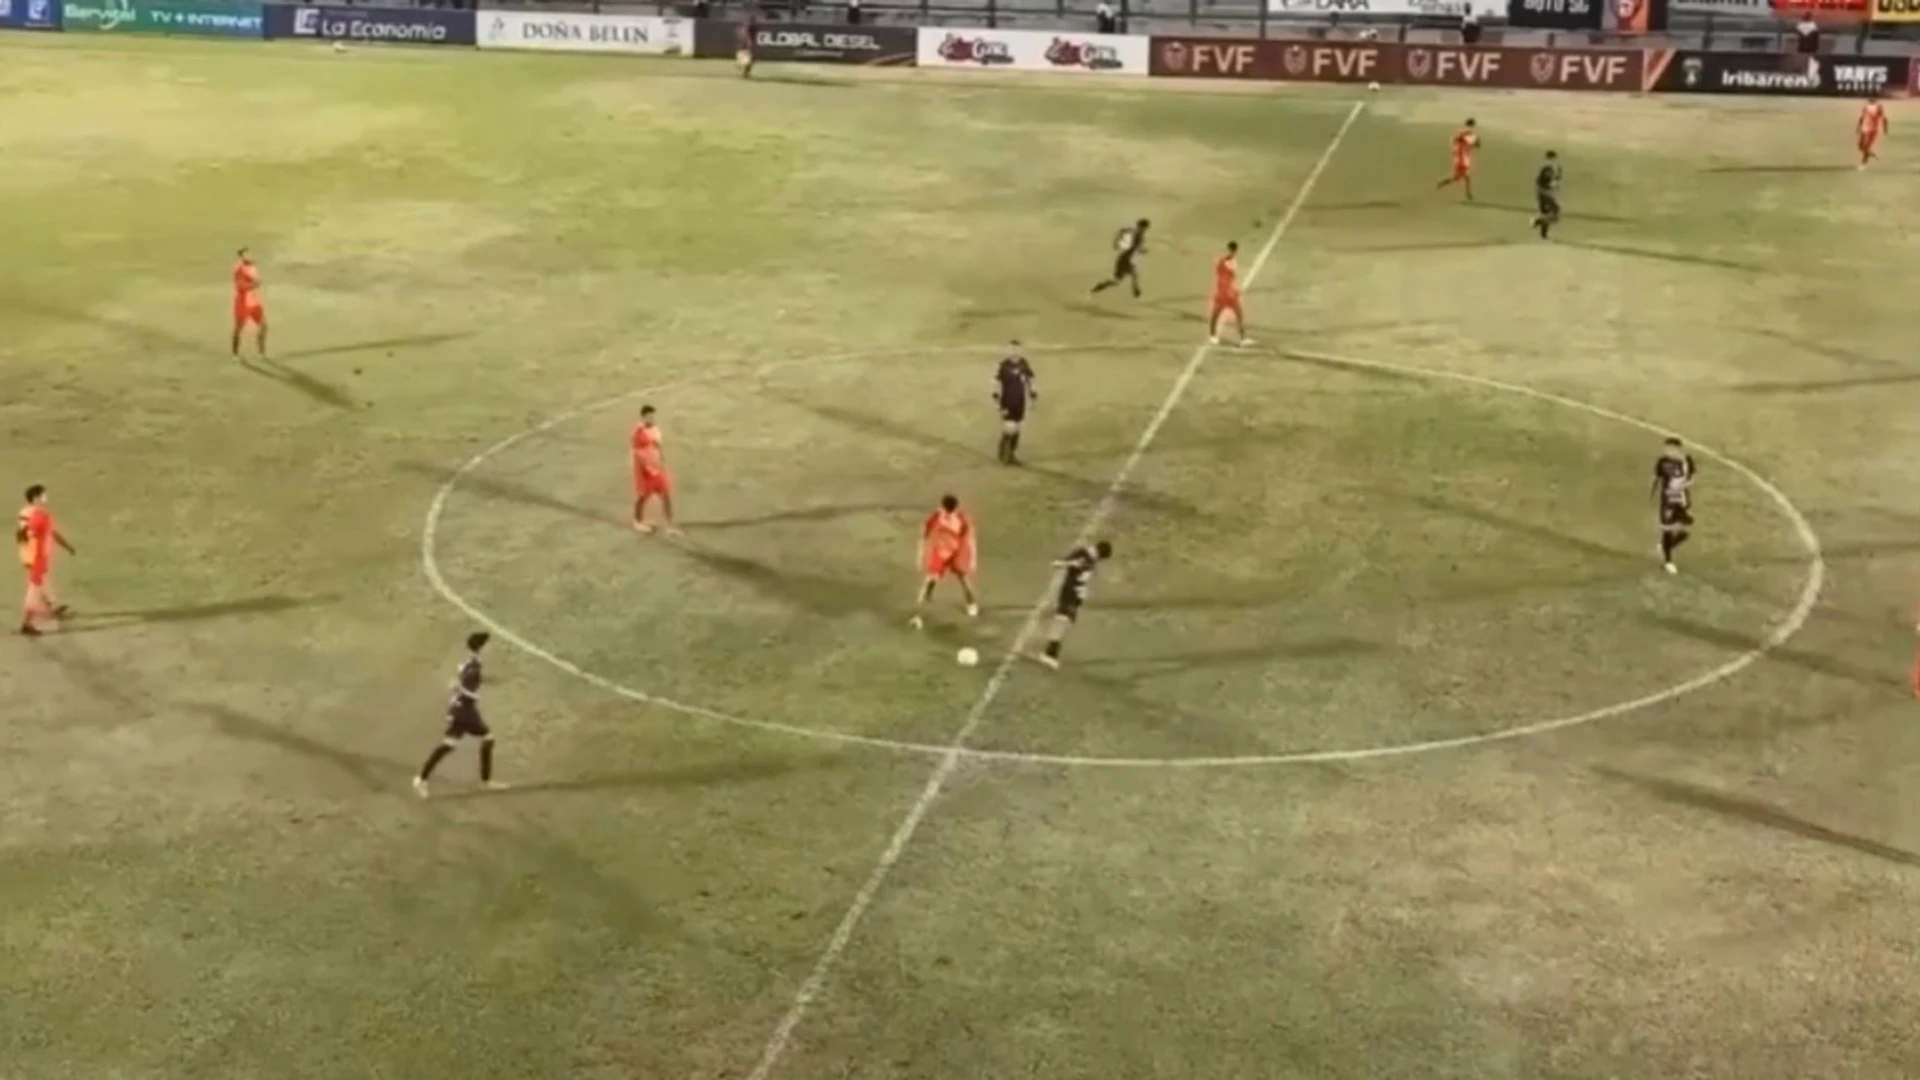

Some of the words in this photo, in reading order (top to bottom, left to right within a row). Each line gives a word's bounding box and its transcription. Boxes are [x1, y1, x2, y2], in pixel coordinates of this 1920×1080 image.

[150, 9, 172, 23] TV
[187, 12, 262, 28] INTERNET
[322, 20, 346, 35] La
[522, 20, 582, 40] DOÑA
[756, 31, 820, 47] GLOBAL
[823, 34, 881, 49] DIESEL
[1192, 45, 1256, 73] FVF
[1313, 48, 1378, 76] FVF
[1437, 52, 1502, 80] FVF
[1560, 55, 1627, 83] FVF
